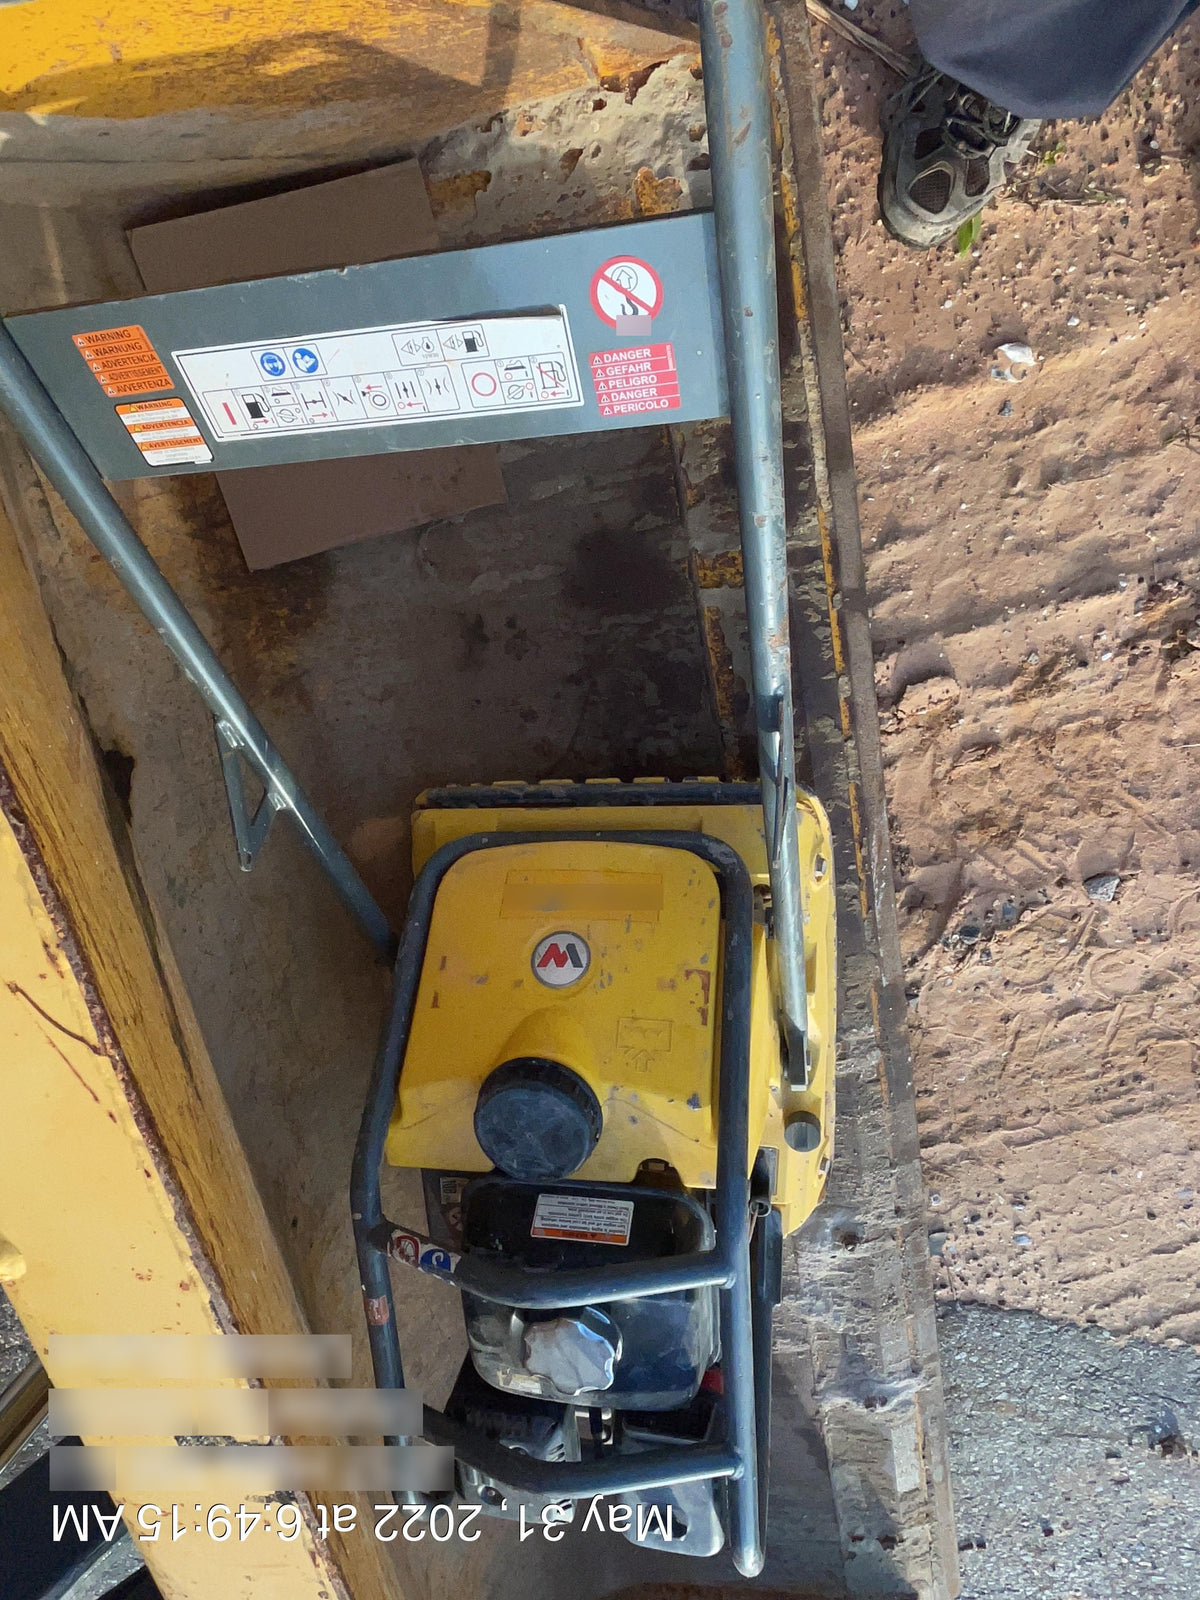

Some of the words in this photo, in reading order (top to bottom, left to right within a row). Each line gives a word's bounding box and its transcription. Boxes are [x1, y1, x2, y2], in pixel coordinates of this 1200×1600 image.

[85, 330, 131, 344] WARNING
[92, 342, 143, 357] WARNUNG
[603, 348, 652, 363] DANGER
[101, 353, 157, 369] ADVERTENCIA
[606, 362, 652, 376] GEFAHR
[116, 378, 171, 393] AVVERTENZA
[608, 375, 657, 389] PELIGRO
[611, 388, 658, 402] DANGER
[137, 400, 172, 410] WARNING
[613, 399, 669, 414] PERICOLO
[142, 419, 189, 430] ADVERTENCIA
